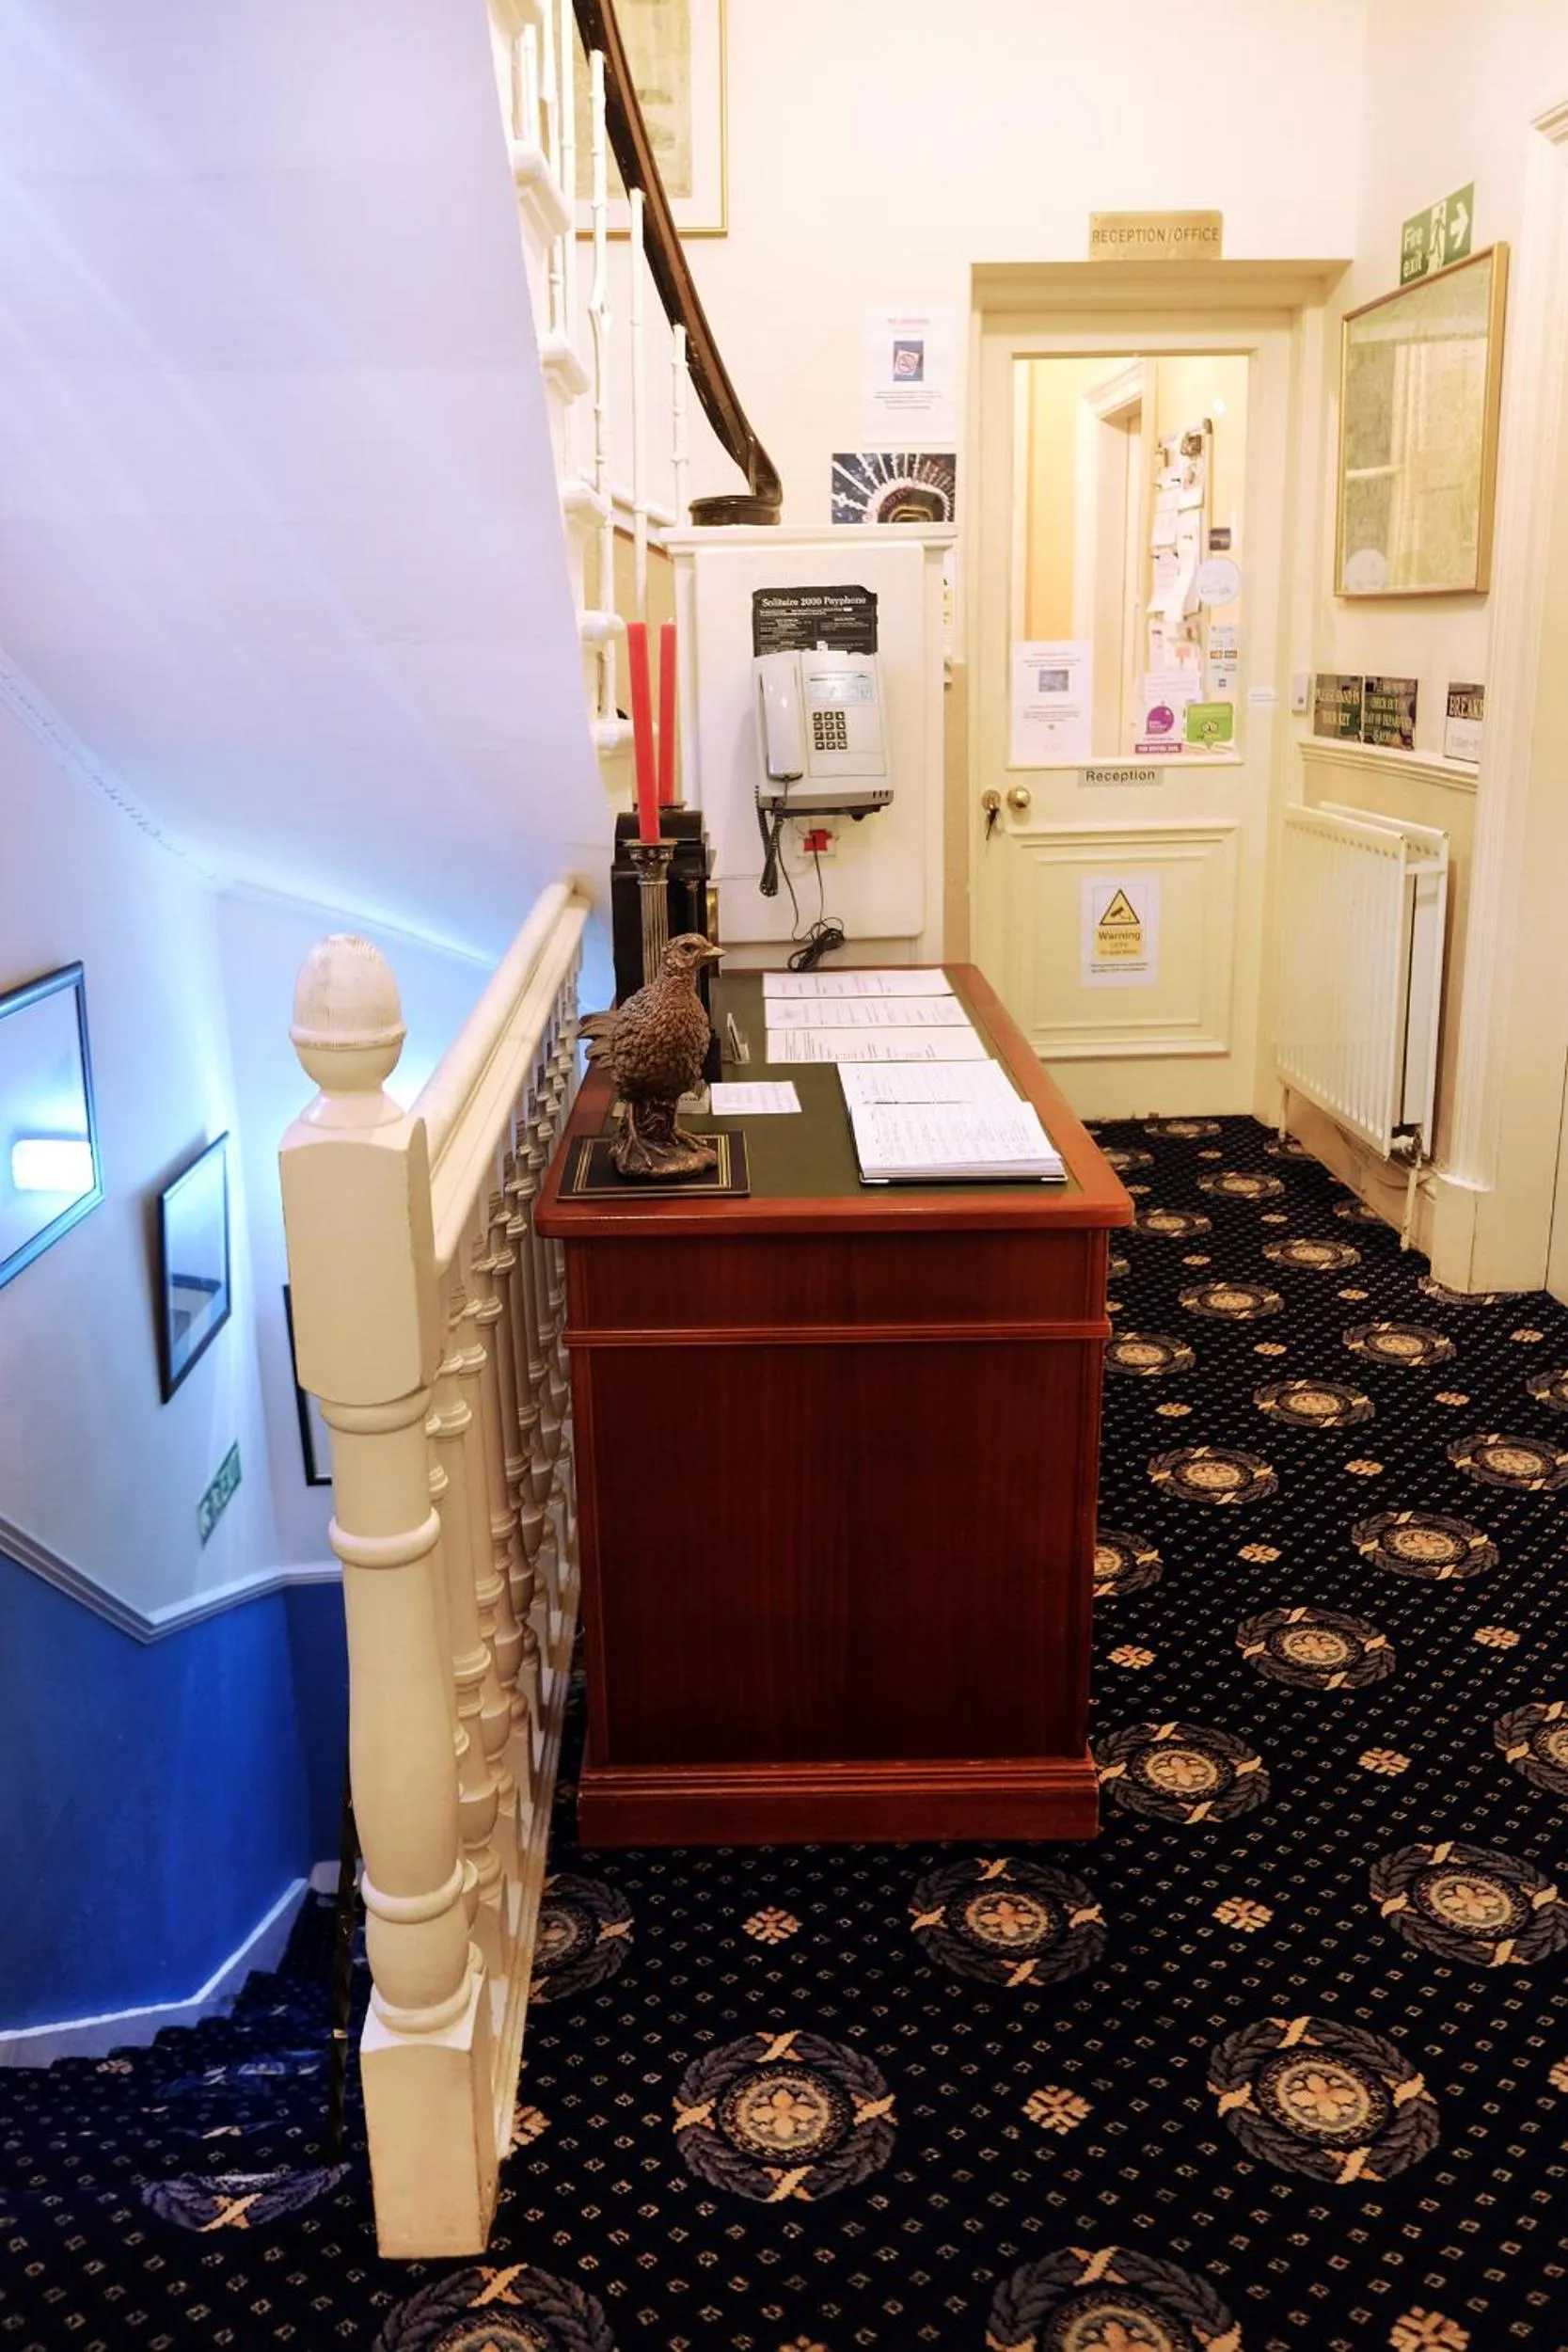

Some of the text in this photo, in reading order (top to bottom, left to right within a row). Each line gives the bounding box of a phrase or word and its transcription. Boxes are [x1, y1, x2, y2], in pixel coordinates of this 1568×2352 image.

[1092, 227, 1219, 244] RECEPTION/OFFICE
[1404, 226, 1424, 252] Fire
[1403, 249, 1423, 278] exit
[761, 596, 799, 608] Solitaire
[1085, 771, 1155, 782] Reception
[1099, 930, 1141, 942] Warning
